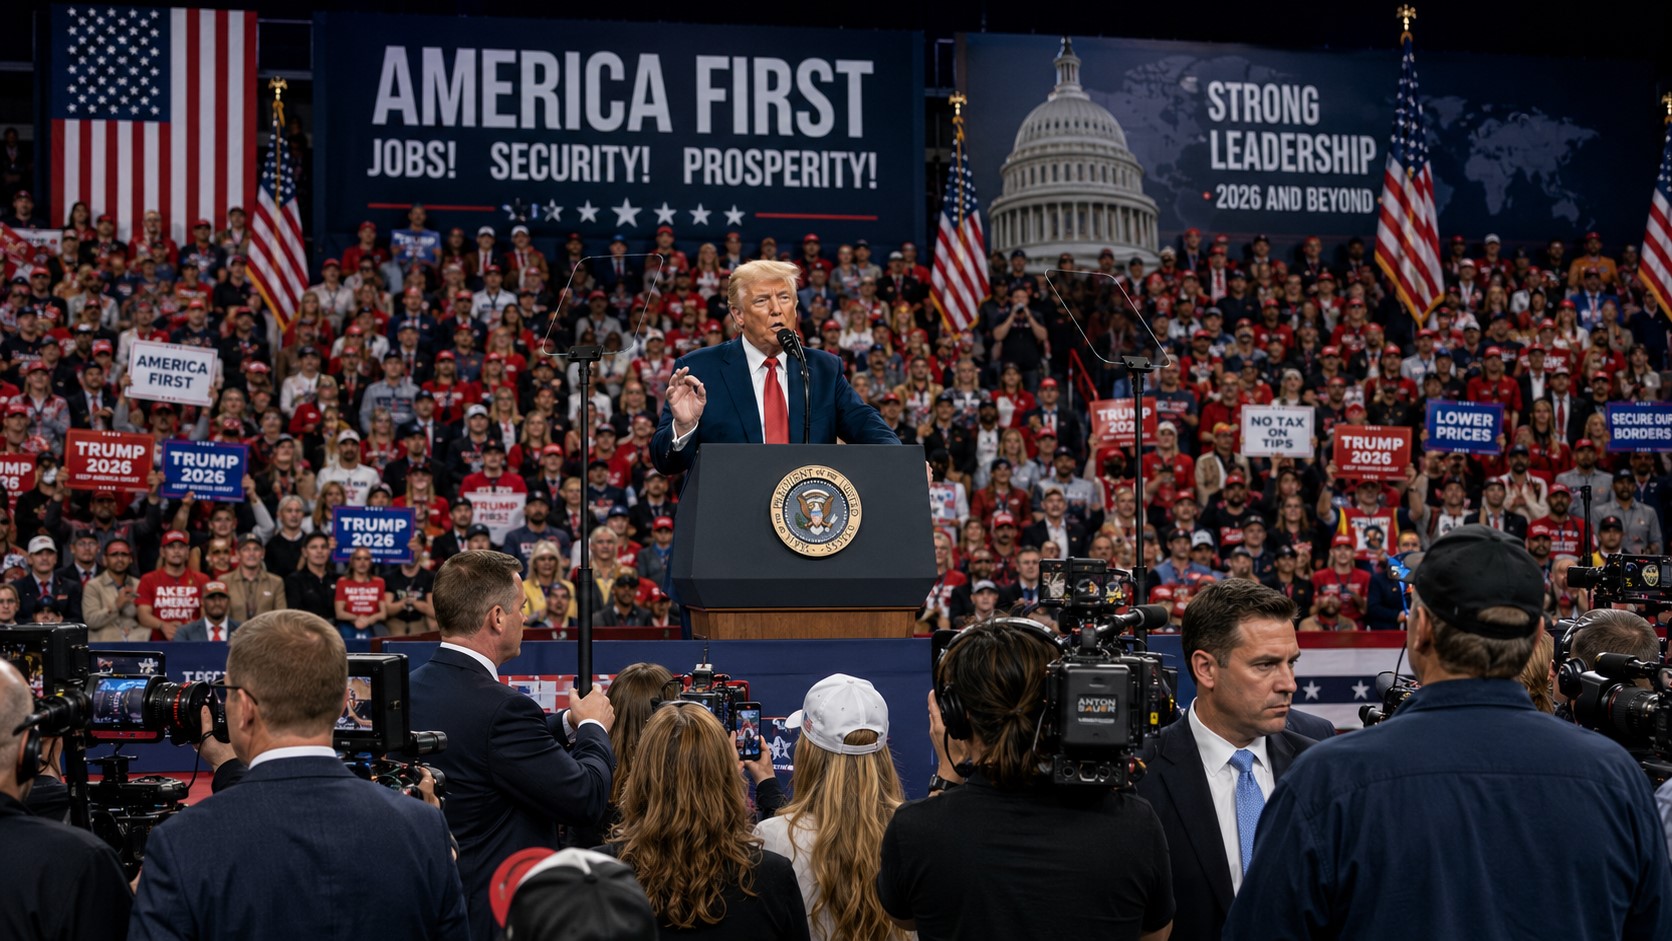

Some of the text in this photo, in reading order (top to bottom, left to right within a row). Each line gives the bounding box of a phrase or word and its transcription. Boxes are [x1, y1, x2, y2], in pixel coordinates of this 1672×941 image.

[372, 45, 874, 138] AMERICA FIRST
[1207, 80, 1319, 125] STRONG
[1210, 130, 1376, 175] LEADERSHIP
[367, 138, 877, 189] JOBS! SECURITY! PROSPERITY!
[1216, 183, 1374, 214] 2026 AND BEYOND
[136, 355, 208, 375] AMERICA
[148, 372, 193, 389] FIRST
[1109, 421, 1144, 433] 202
[1251, 416, 1305, 428] NO TAX
[1436, 410, 1494, 428] LOWER
[1612, 412, 1653, 425] SECURE
[1268, 428, 1288, 438] ON
[1436, 425, 1492, 443] PRICES
[1614, 427, 1672, 440] BORDERS
[75, 441, 146, 460] TRUMP
[1262, 438, 1294, 449] TIPS
[1341, 435, 1404, 452] TRUMP
[86, 458, 132, 475] 2026
[170, 451, 239, 470] TRUMP
[1351, 450, 1392, 466] 2026
[181, 468, 226, 485] 2026
[340, 516, 408, 533] TRUMP
[351, 532, 395, 548] 2026
[1078, 697, 1116, 706] ANTON
